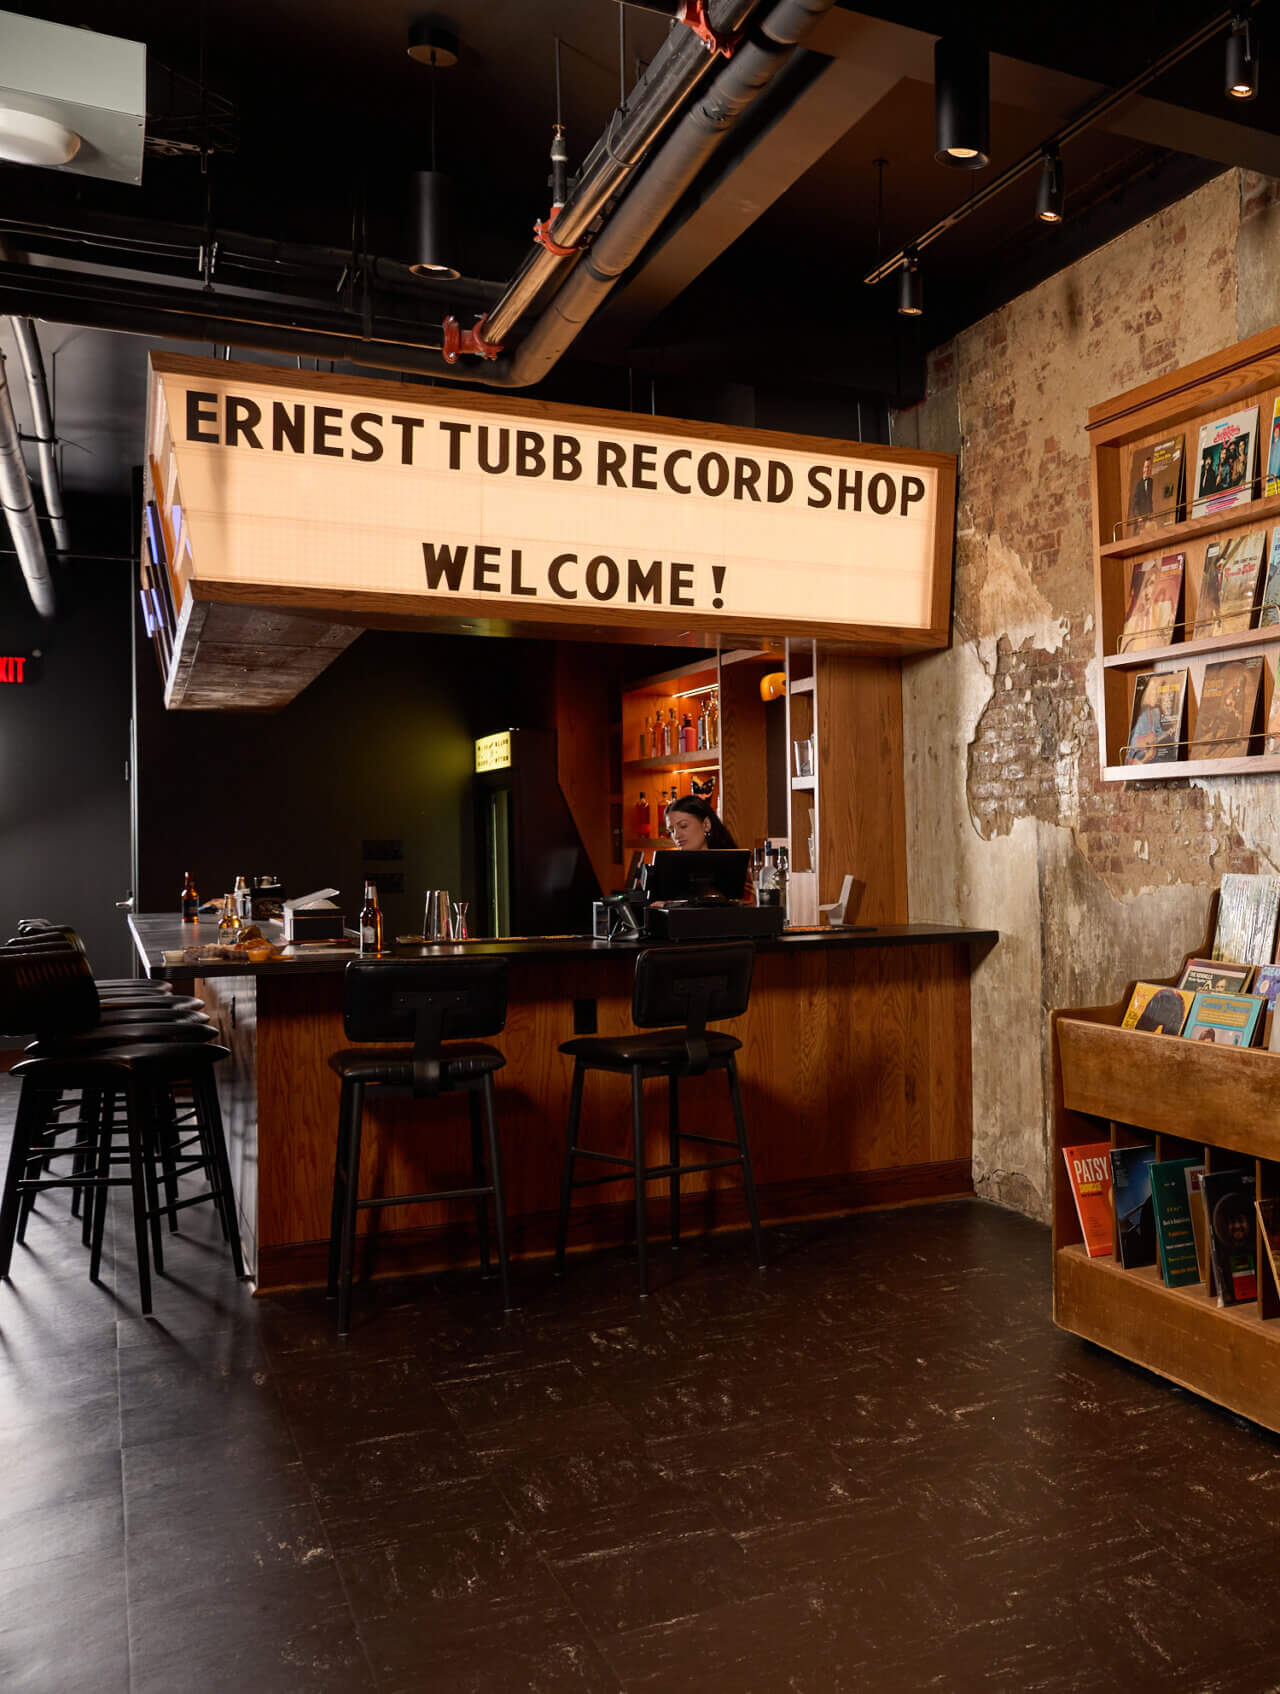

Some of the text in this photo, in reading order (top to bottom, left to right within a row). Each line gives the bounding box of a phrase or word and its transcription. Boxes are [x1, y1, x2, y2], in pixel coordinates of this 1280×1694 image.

[184, 390, 925, 517] ERNEST TUBB RECORD SHOP
[0, 657, 26, 683] XIT
[1073, 1156, 1109, 1183] PATSY
